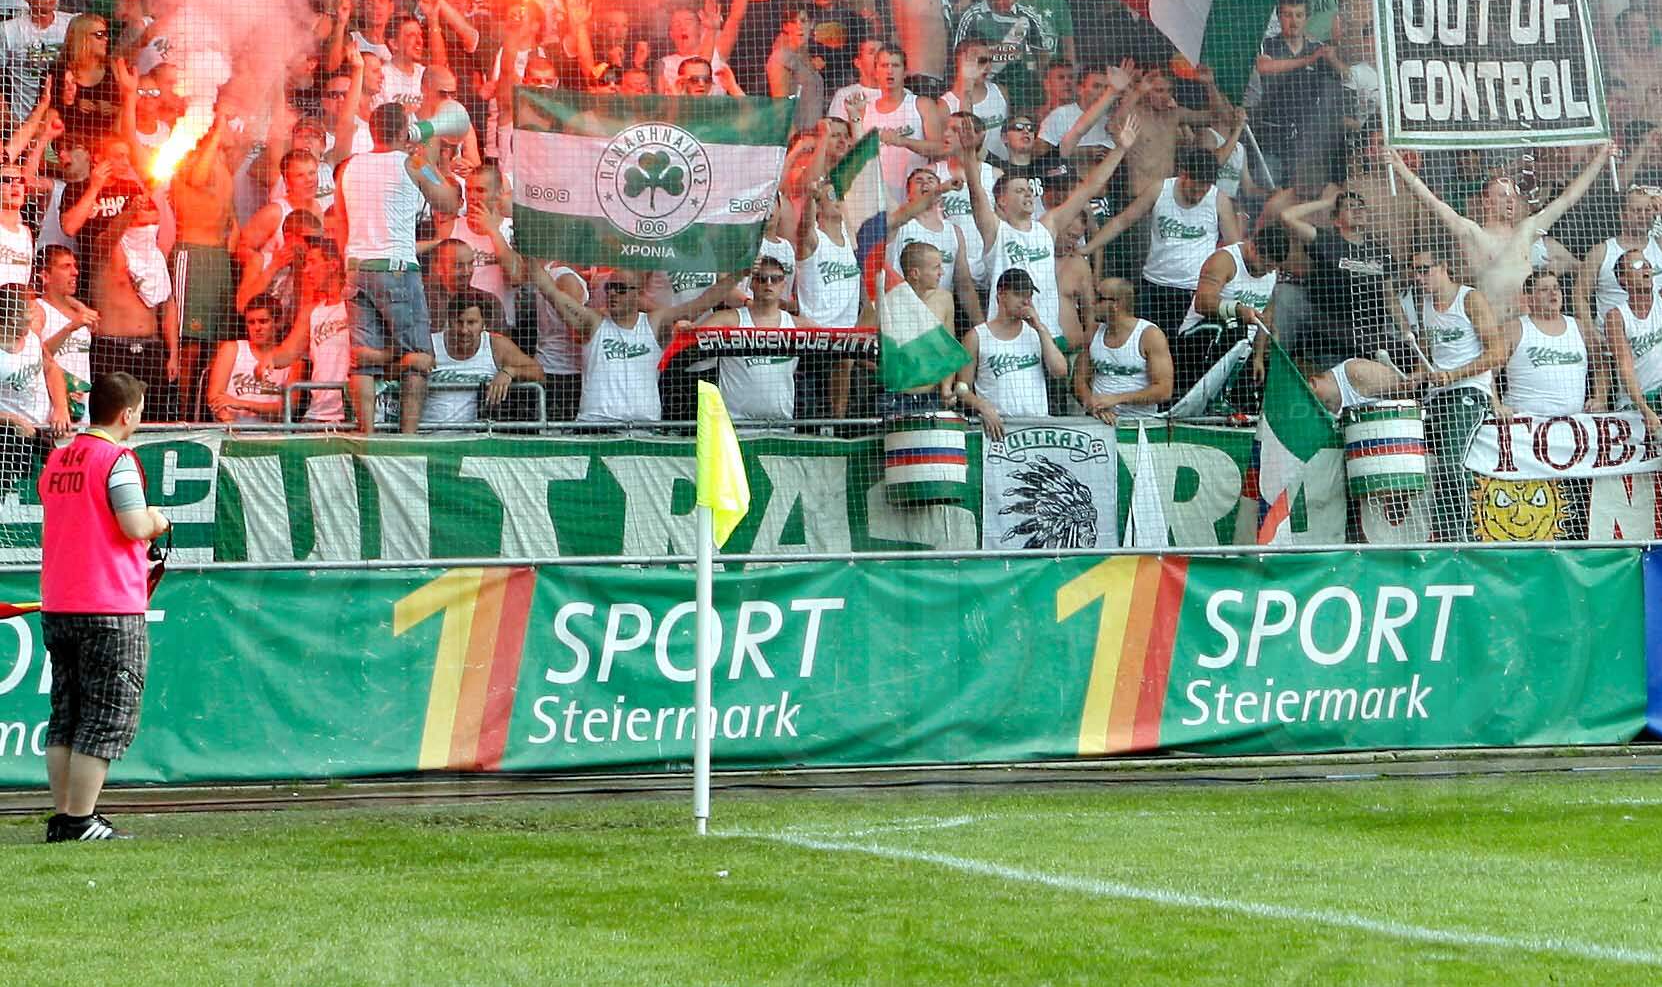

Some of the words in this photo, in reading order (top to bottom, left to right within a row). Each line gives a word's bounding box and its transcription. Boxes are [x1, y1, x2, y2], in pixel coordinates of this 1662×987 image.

[1400, 57, 1588, 123] CONTROL
[635, 219, 667, 234] 100
[60, 448, 87, 467] 414
[1005, 428, 1085, 450] ULTRAS
[546, 597, 845, 686] SPORT
[1197, 585, 1475, 669] SPORT
[529, 692, 801, 745] Steiermark
[1182, 674, 1434, 726] Steiermark
